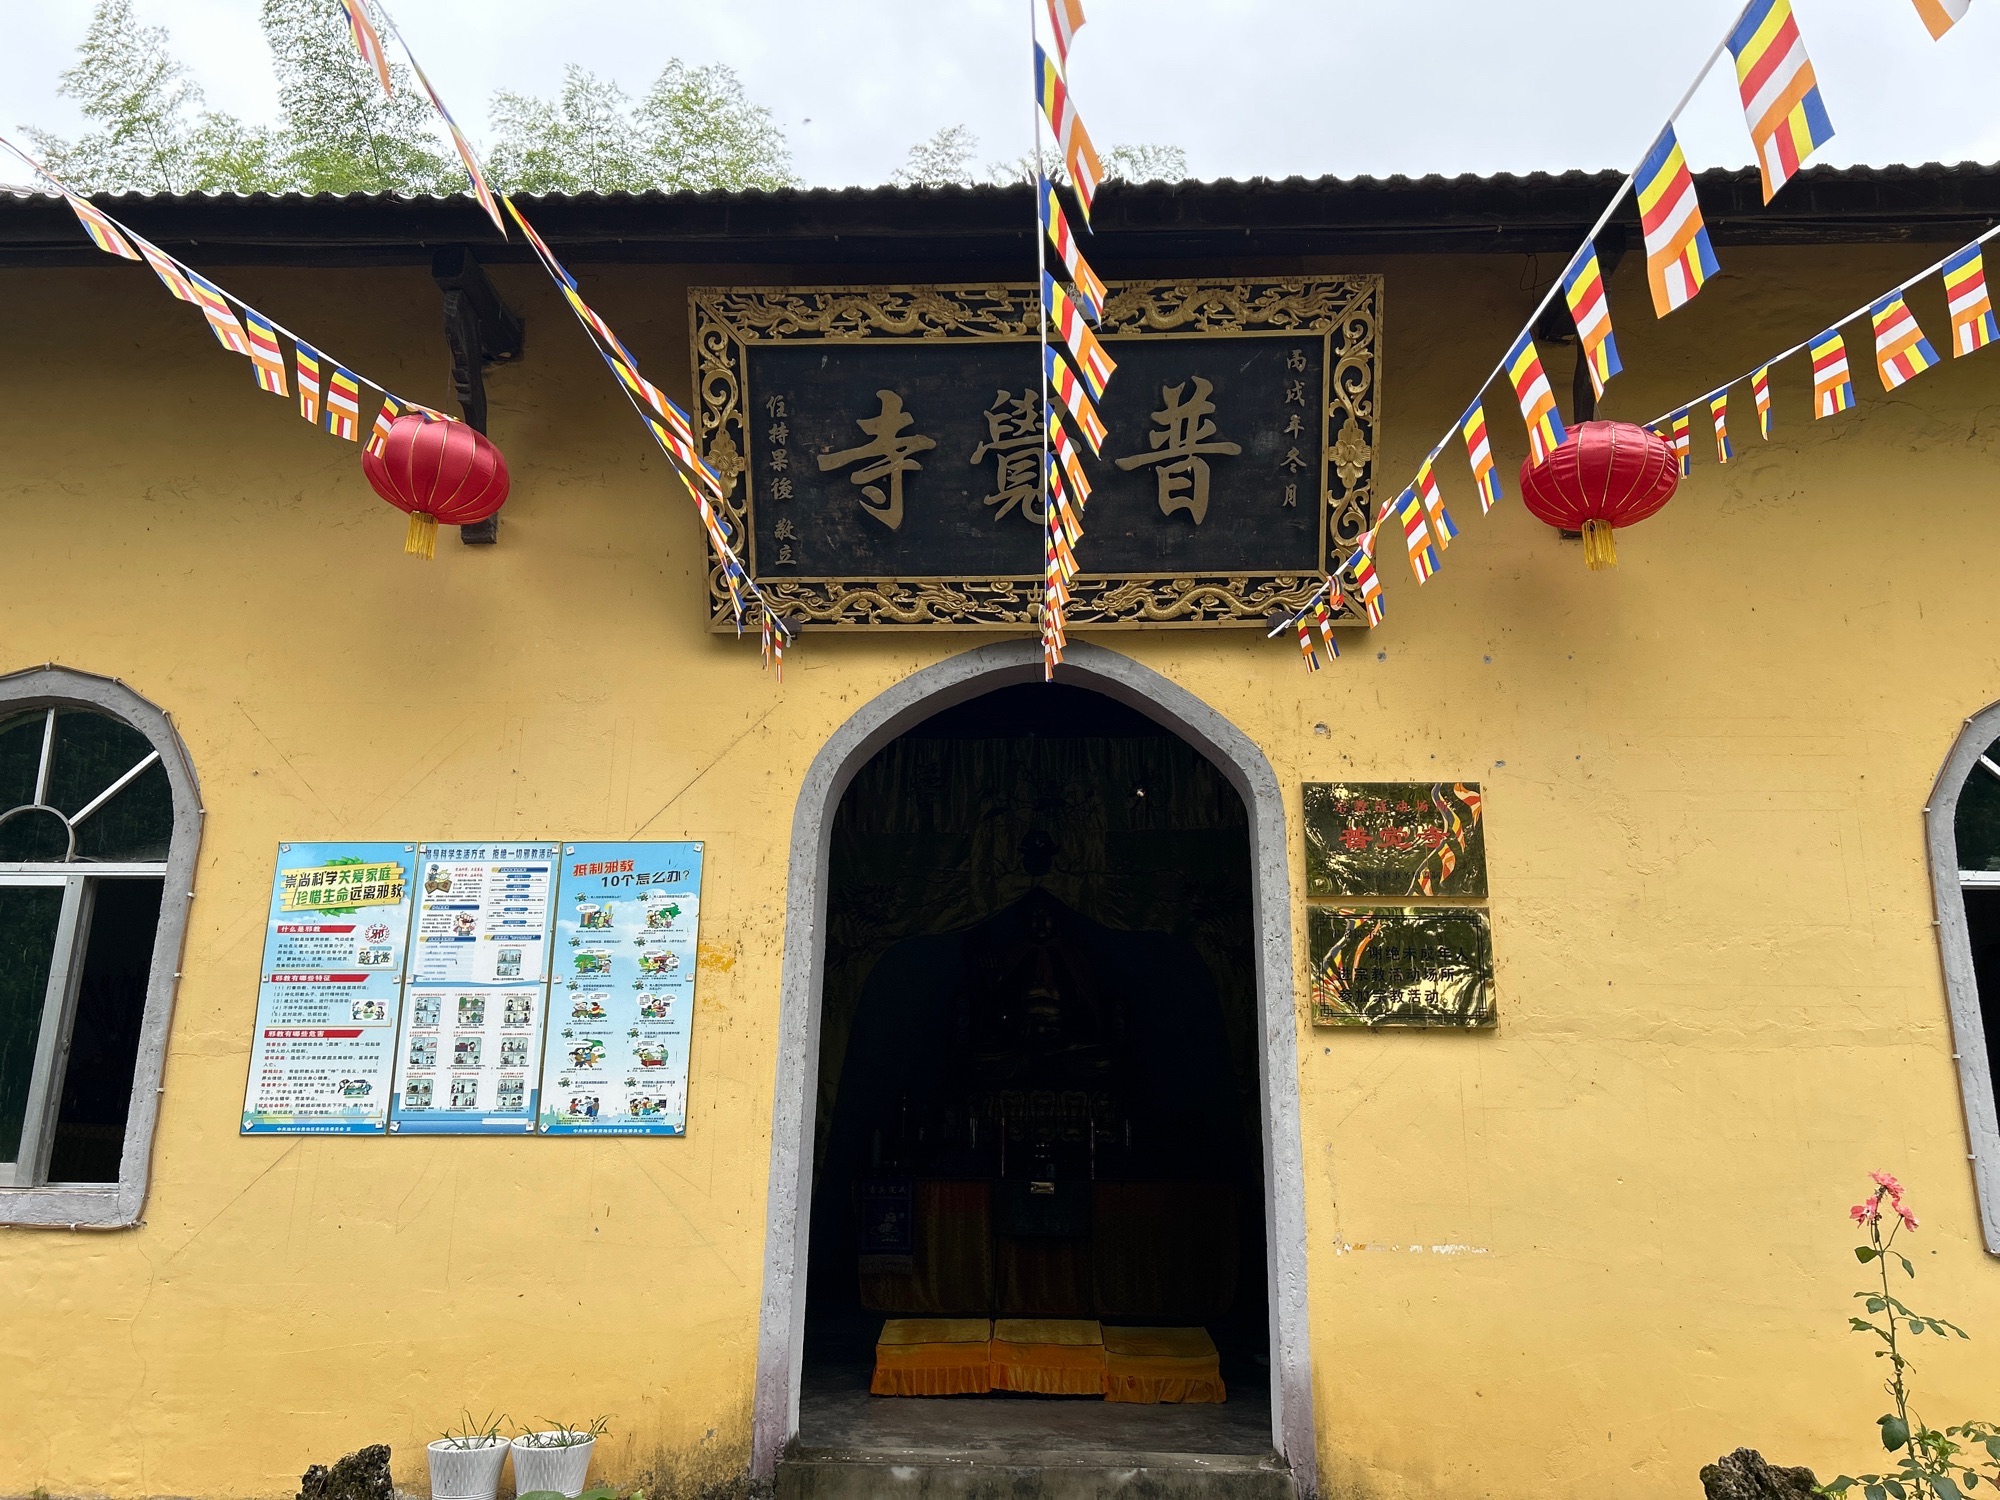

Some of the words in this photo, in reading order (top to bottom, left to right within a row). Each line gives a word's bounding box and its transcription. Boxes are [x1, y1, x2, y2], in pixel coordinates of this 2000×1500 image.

[1338, 826, 1450, 849] 普觉寺
[573, 860, 634, 876] 抵制邪教
[284, 867, 392, 888] 崇尚科学关爱家庭
[601, 870, 691, 887] 10个怎么办?
[295, 884, 404, 905] 珍惜生命远离邪教
[281, 925, 321, 933] 什么是邪教
[1368, 945, 1469, 961] 谢绝未成年人
[268, 1030, 325, 1038] 邪教有哪些危害
